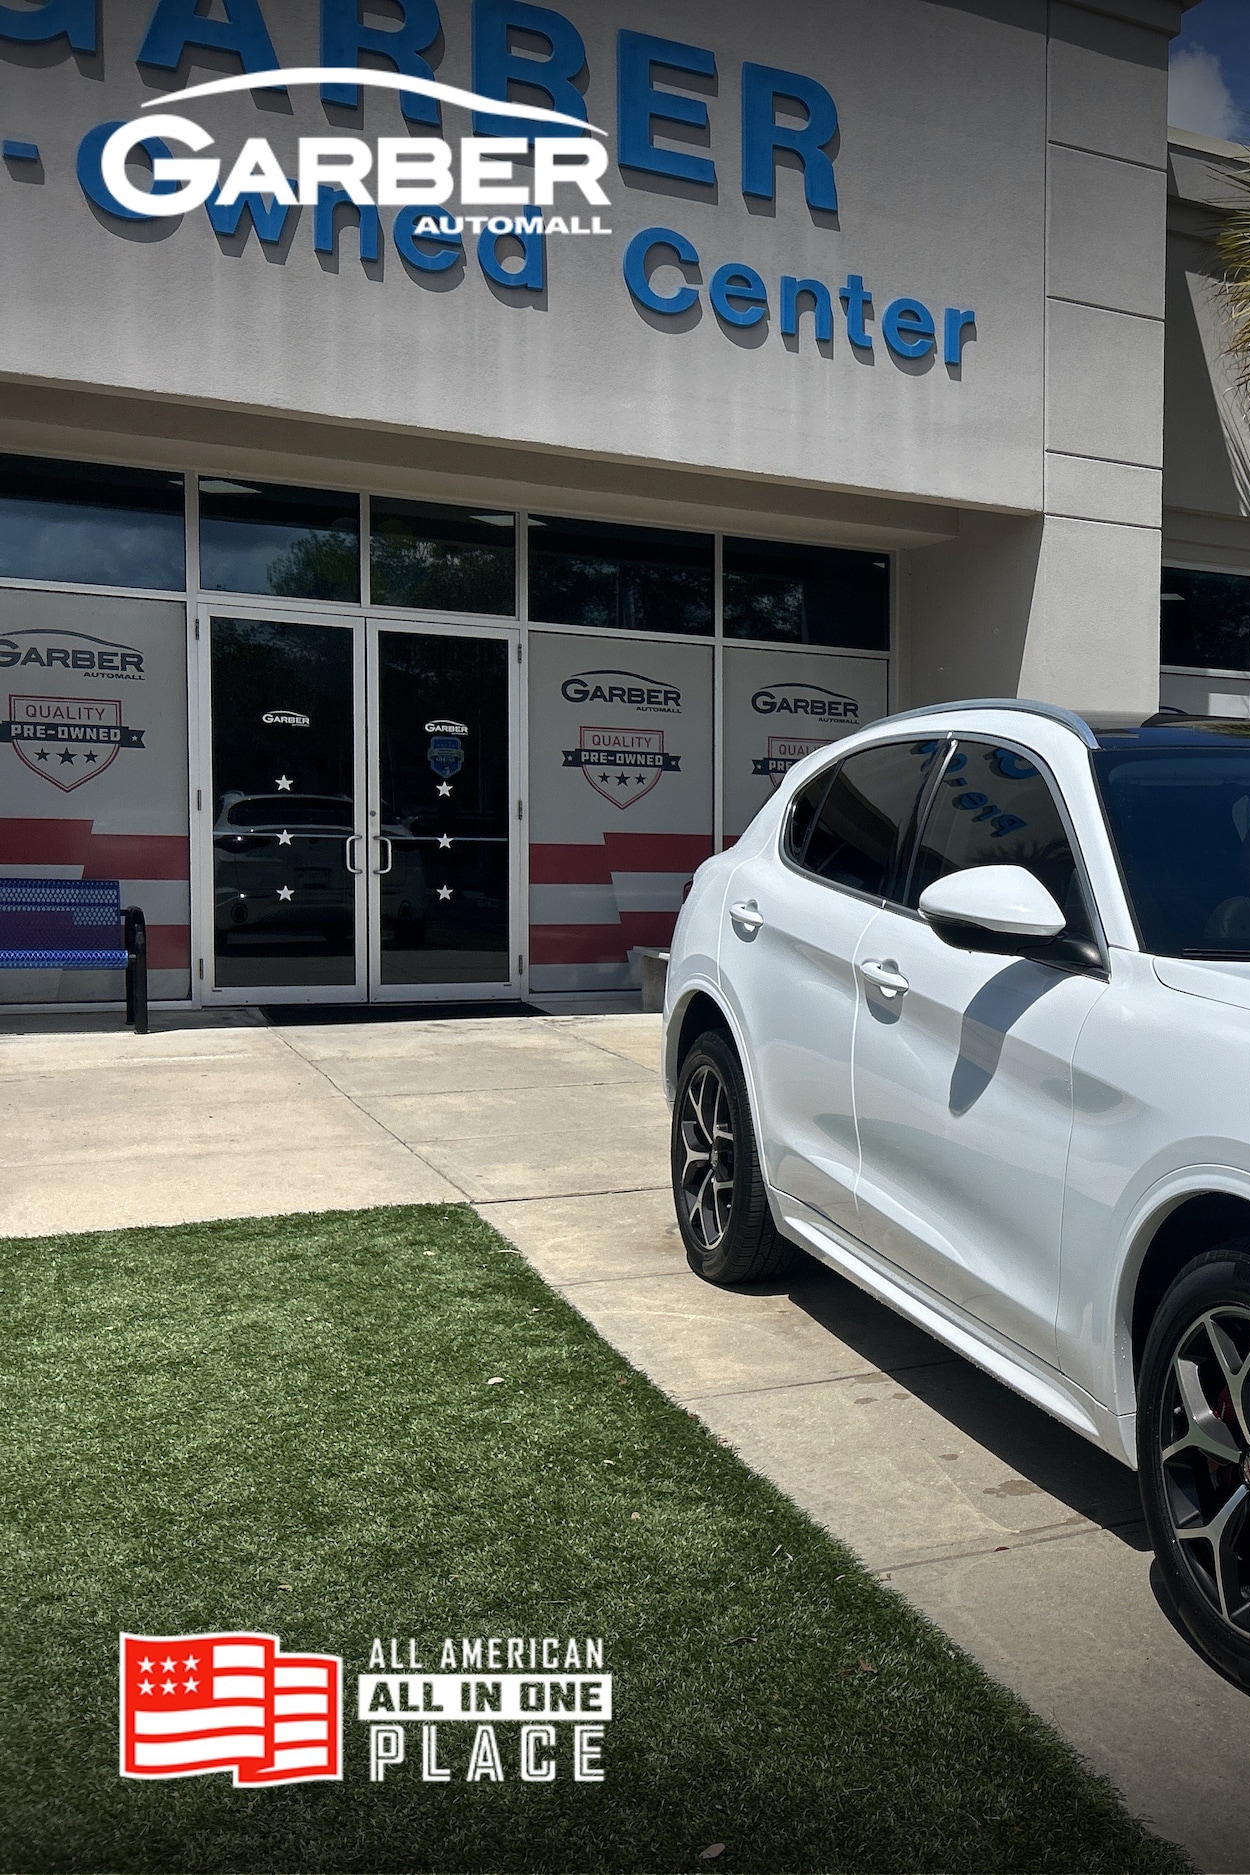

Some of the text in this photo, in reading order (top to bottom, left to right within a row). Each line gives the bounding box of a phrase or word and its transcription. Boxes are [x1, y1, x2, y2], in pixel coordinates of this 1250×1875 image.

[622, 226, 976, 366] Center
[83, 672, 146, 681] AUTOMALL
[561, 678, 681, 706] GARBER
[25, 704, 105, 721] QUALITY
[751, 691, 859, 718] GARBER
[818, 717, 860, 725] AUTOMALL
[10, 724, 121, 741] PRE-OWNED
[592, 735, 652, 748] QUALITY
[580, 751, 664, 766] PRE-OWNED
